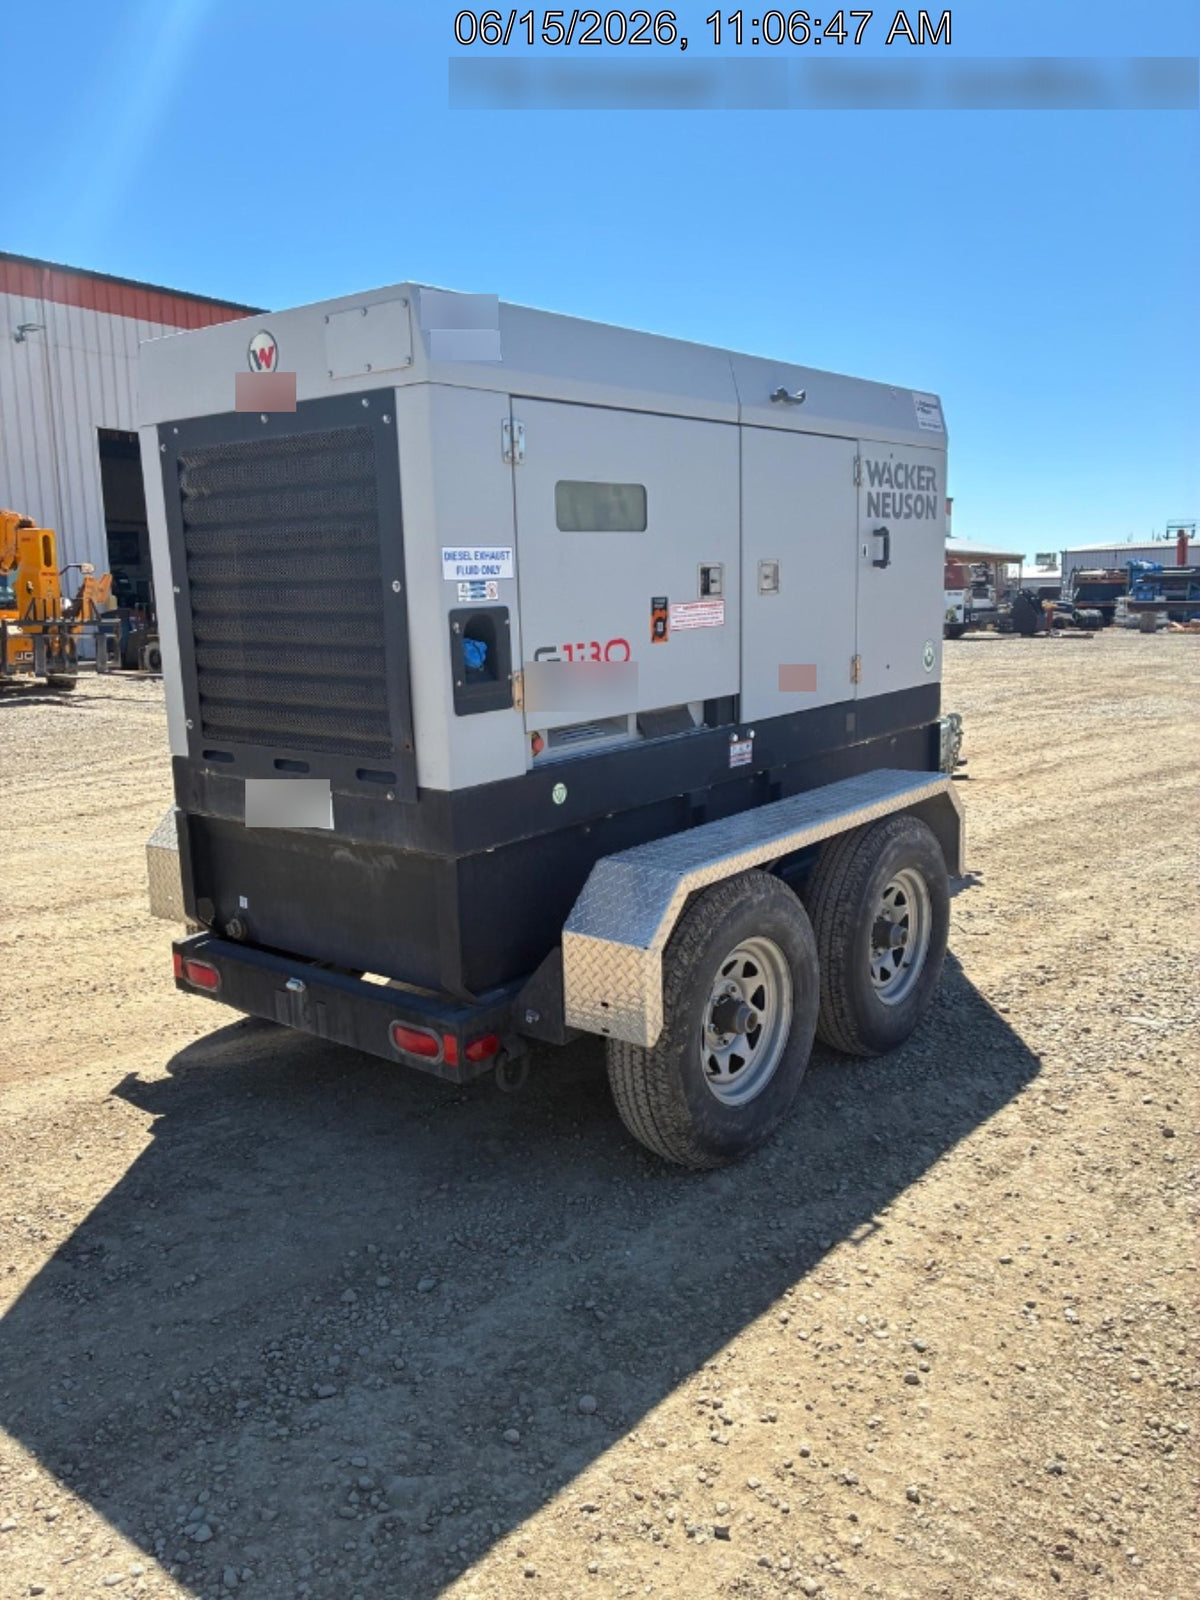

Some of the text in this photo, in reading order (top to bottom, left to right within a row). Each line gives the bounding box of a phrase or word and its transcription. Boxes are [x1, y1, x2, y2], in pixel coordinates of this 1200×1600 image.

[865, 459, 938, 492] WACKER
[866, 491, 938, 520] NEUSON
[444, 550, 511, 561] DIESEL EXHAUST
[456, 564, 502, 576] FLUID ONLY
